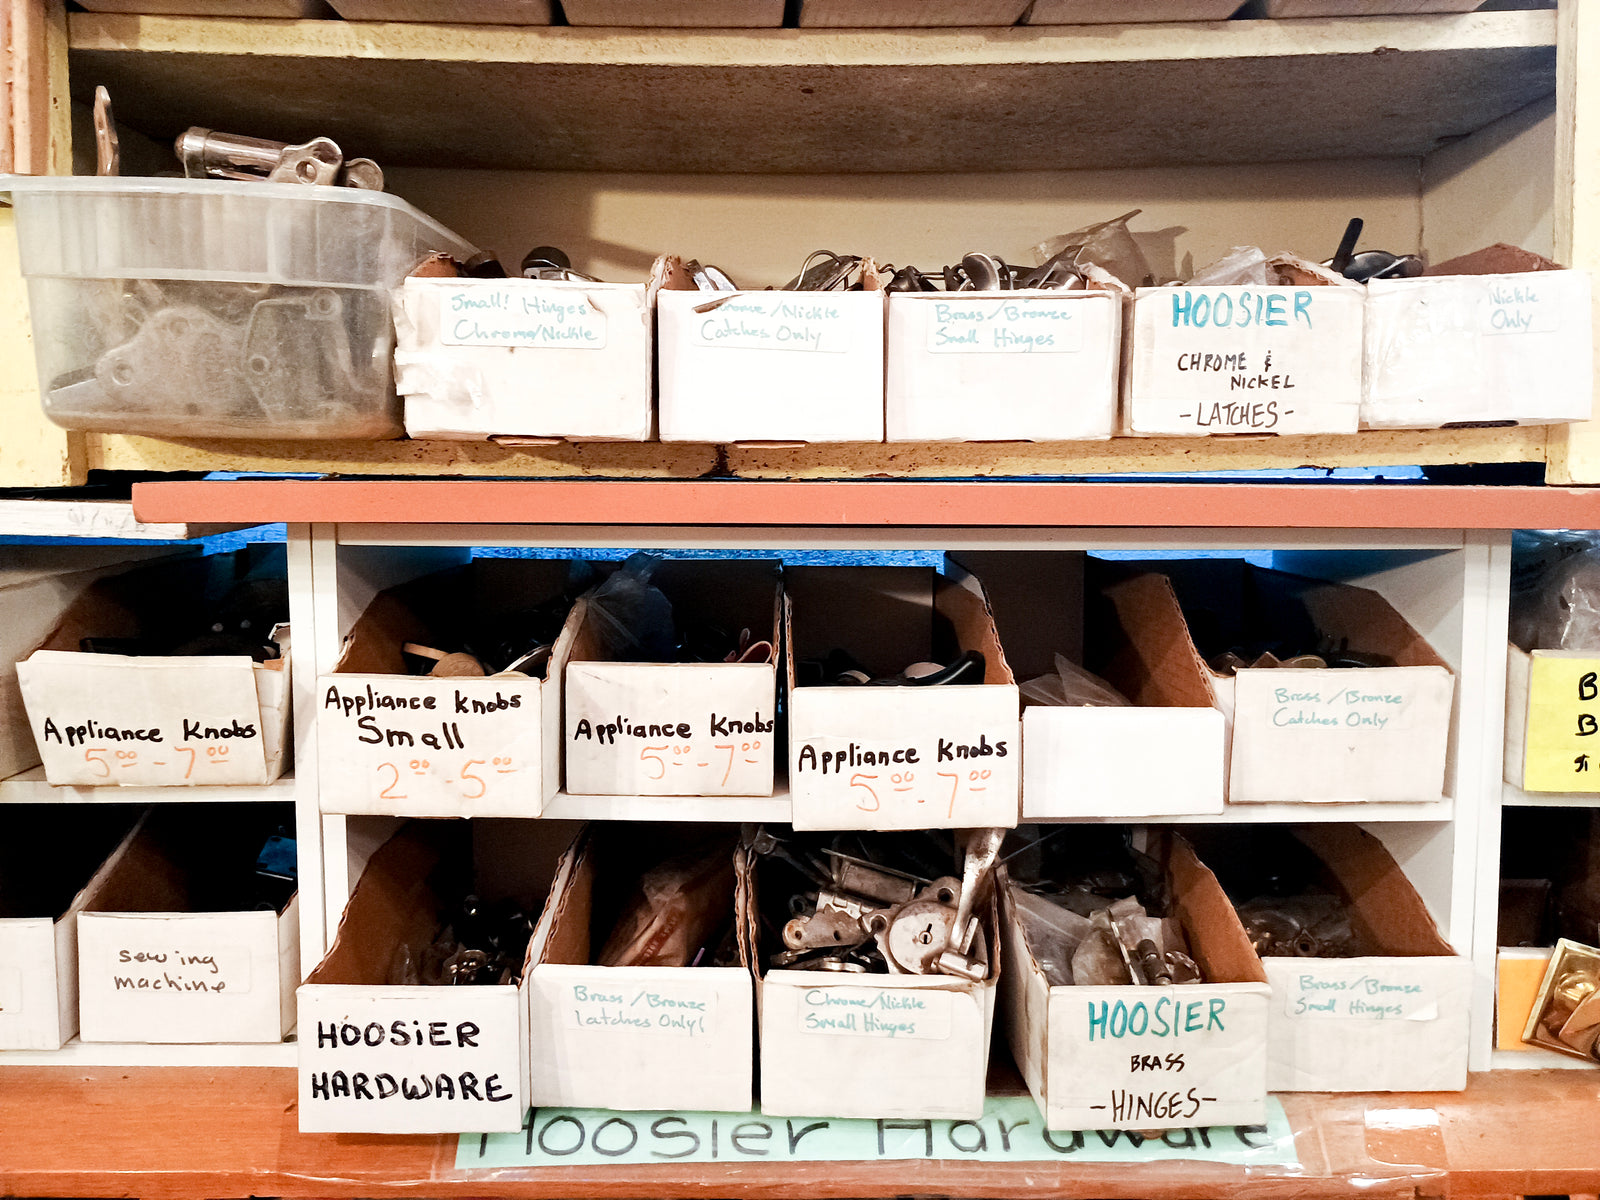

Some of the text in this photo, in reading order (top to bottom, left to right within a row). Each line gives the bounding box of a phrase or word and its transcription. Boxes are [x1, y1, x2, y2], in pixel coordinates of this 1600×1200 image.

[522, 296, 586, 323] Hinges
[1172, 291, 1312, 329] HOOSIER
[1490, 308, 1532, 332] Only
[701, 319, 821, 350] Catches Only
[936, 327, 1054, 352] Small Hinges
[1177, 352, 1247, 372] CHROME
[1230, 374, 1295, 390] NICKEL
[325, 684, 437, 717] Appliance
[574, 715, 692, 744] Appliance
[1273, 706, 1389, 730] Catches Only
[45, 717, 163, 747] Appliance
[357, 716, 465, 750] Small
[798, 743, 920, 774] Appliance
[114, 972, 226, 993] machine
[1088, 997, 1226, 1042] HOOSIER
[1294, 997, 1403, 1020] Small Hinges
[805, 1013, 916, 1038] Small Hinges
[1131, 1053, 1185, 1073] BRASS
[311, 1070, 513, 1102] HARDWARE
